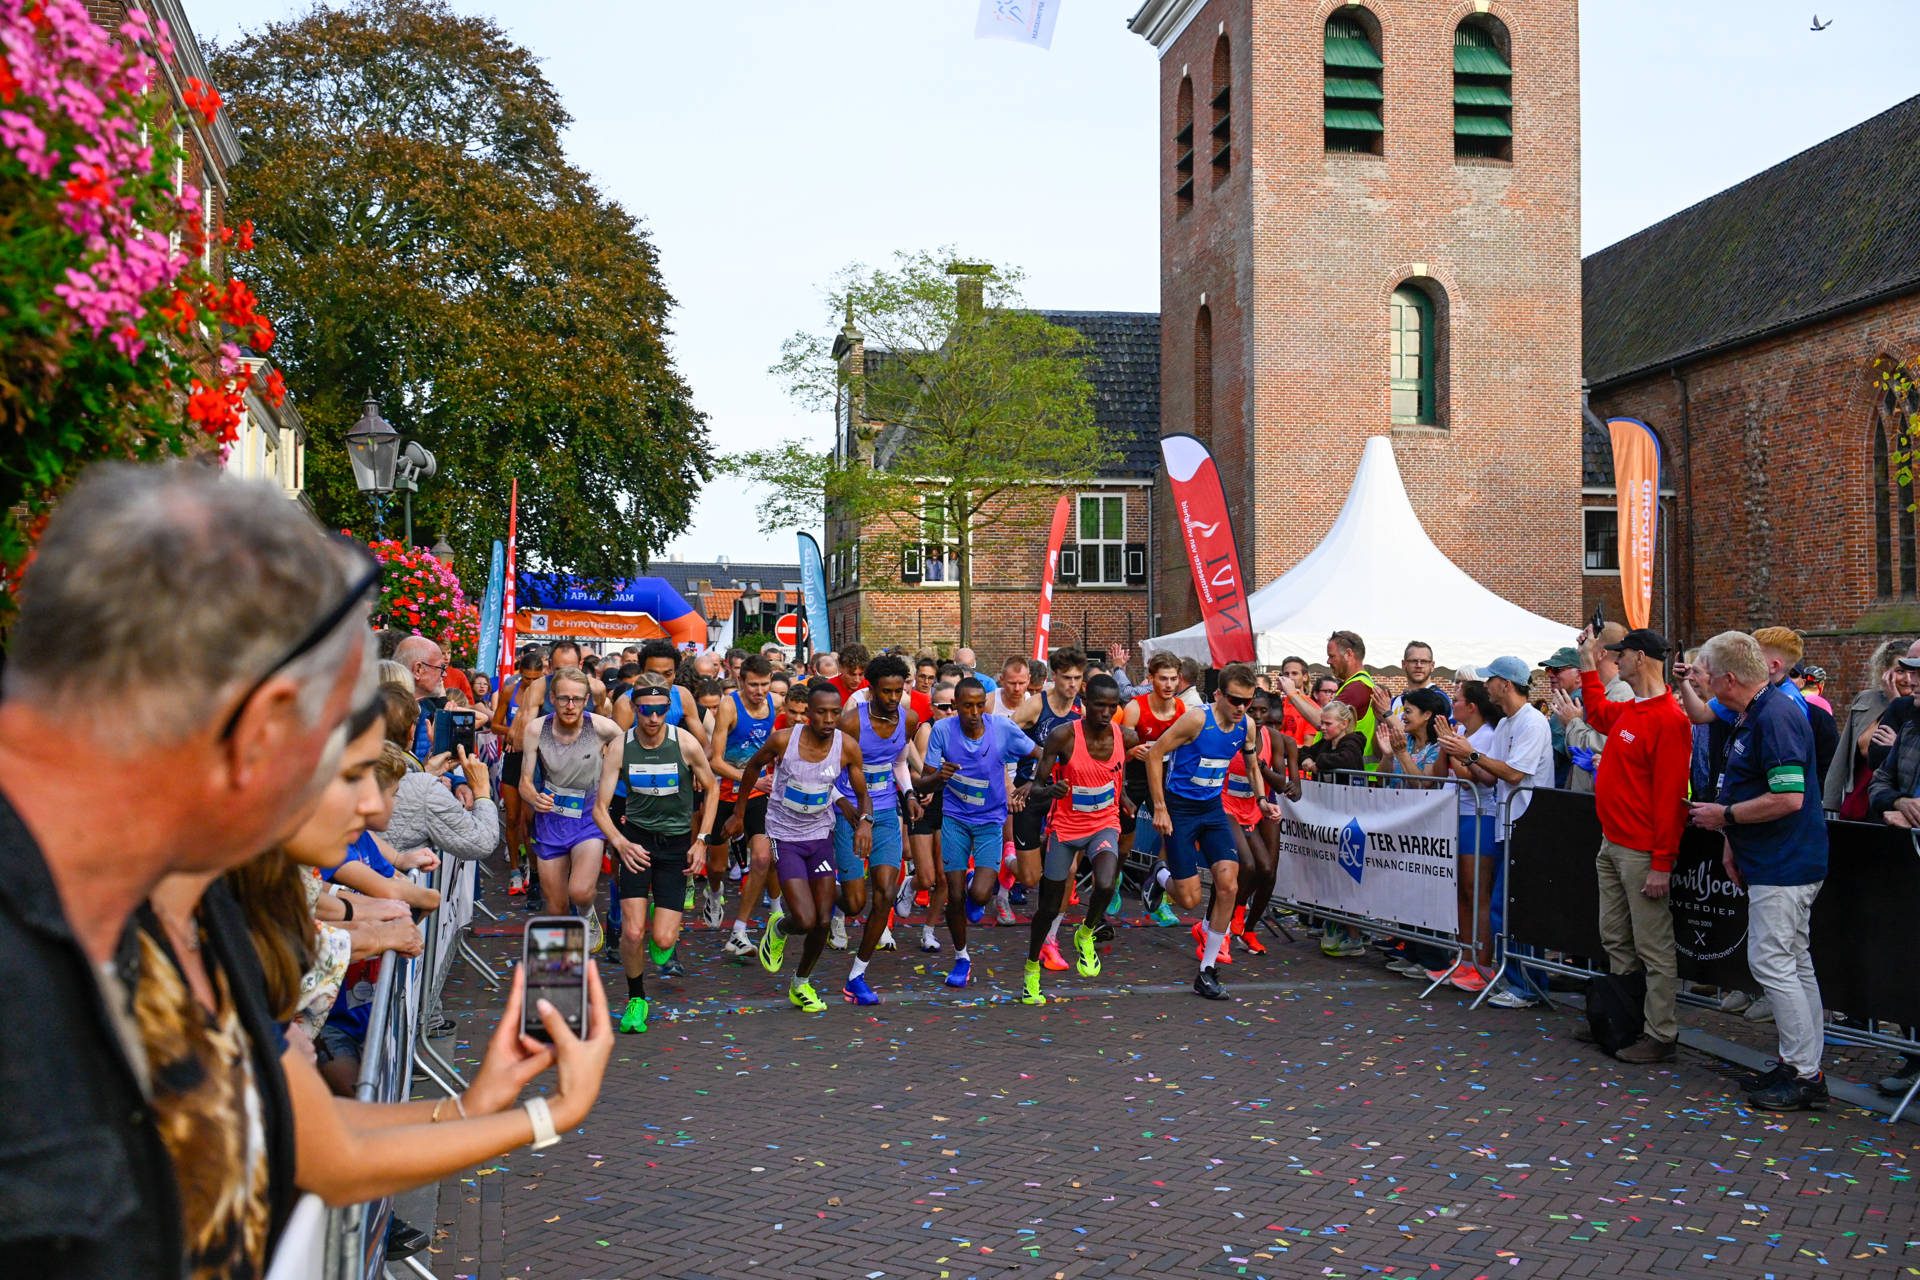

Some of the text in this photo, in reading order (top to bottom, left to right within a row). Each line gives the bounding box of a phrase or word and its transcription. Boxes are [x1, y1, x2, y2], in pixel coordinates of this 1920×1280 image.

[552, 619, 565, 628] DE
[1280, 817, 1339, 846] CHONEWILLE
[1367, 831, 1394, 854] TER
[1400, 834, 1453, 860] HARKEL
[1279, 841, 1454, 879] ERZEKERINGEN FINANCIERINGEN
[1671, 859, 1745, 902] aviljoen
